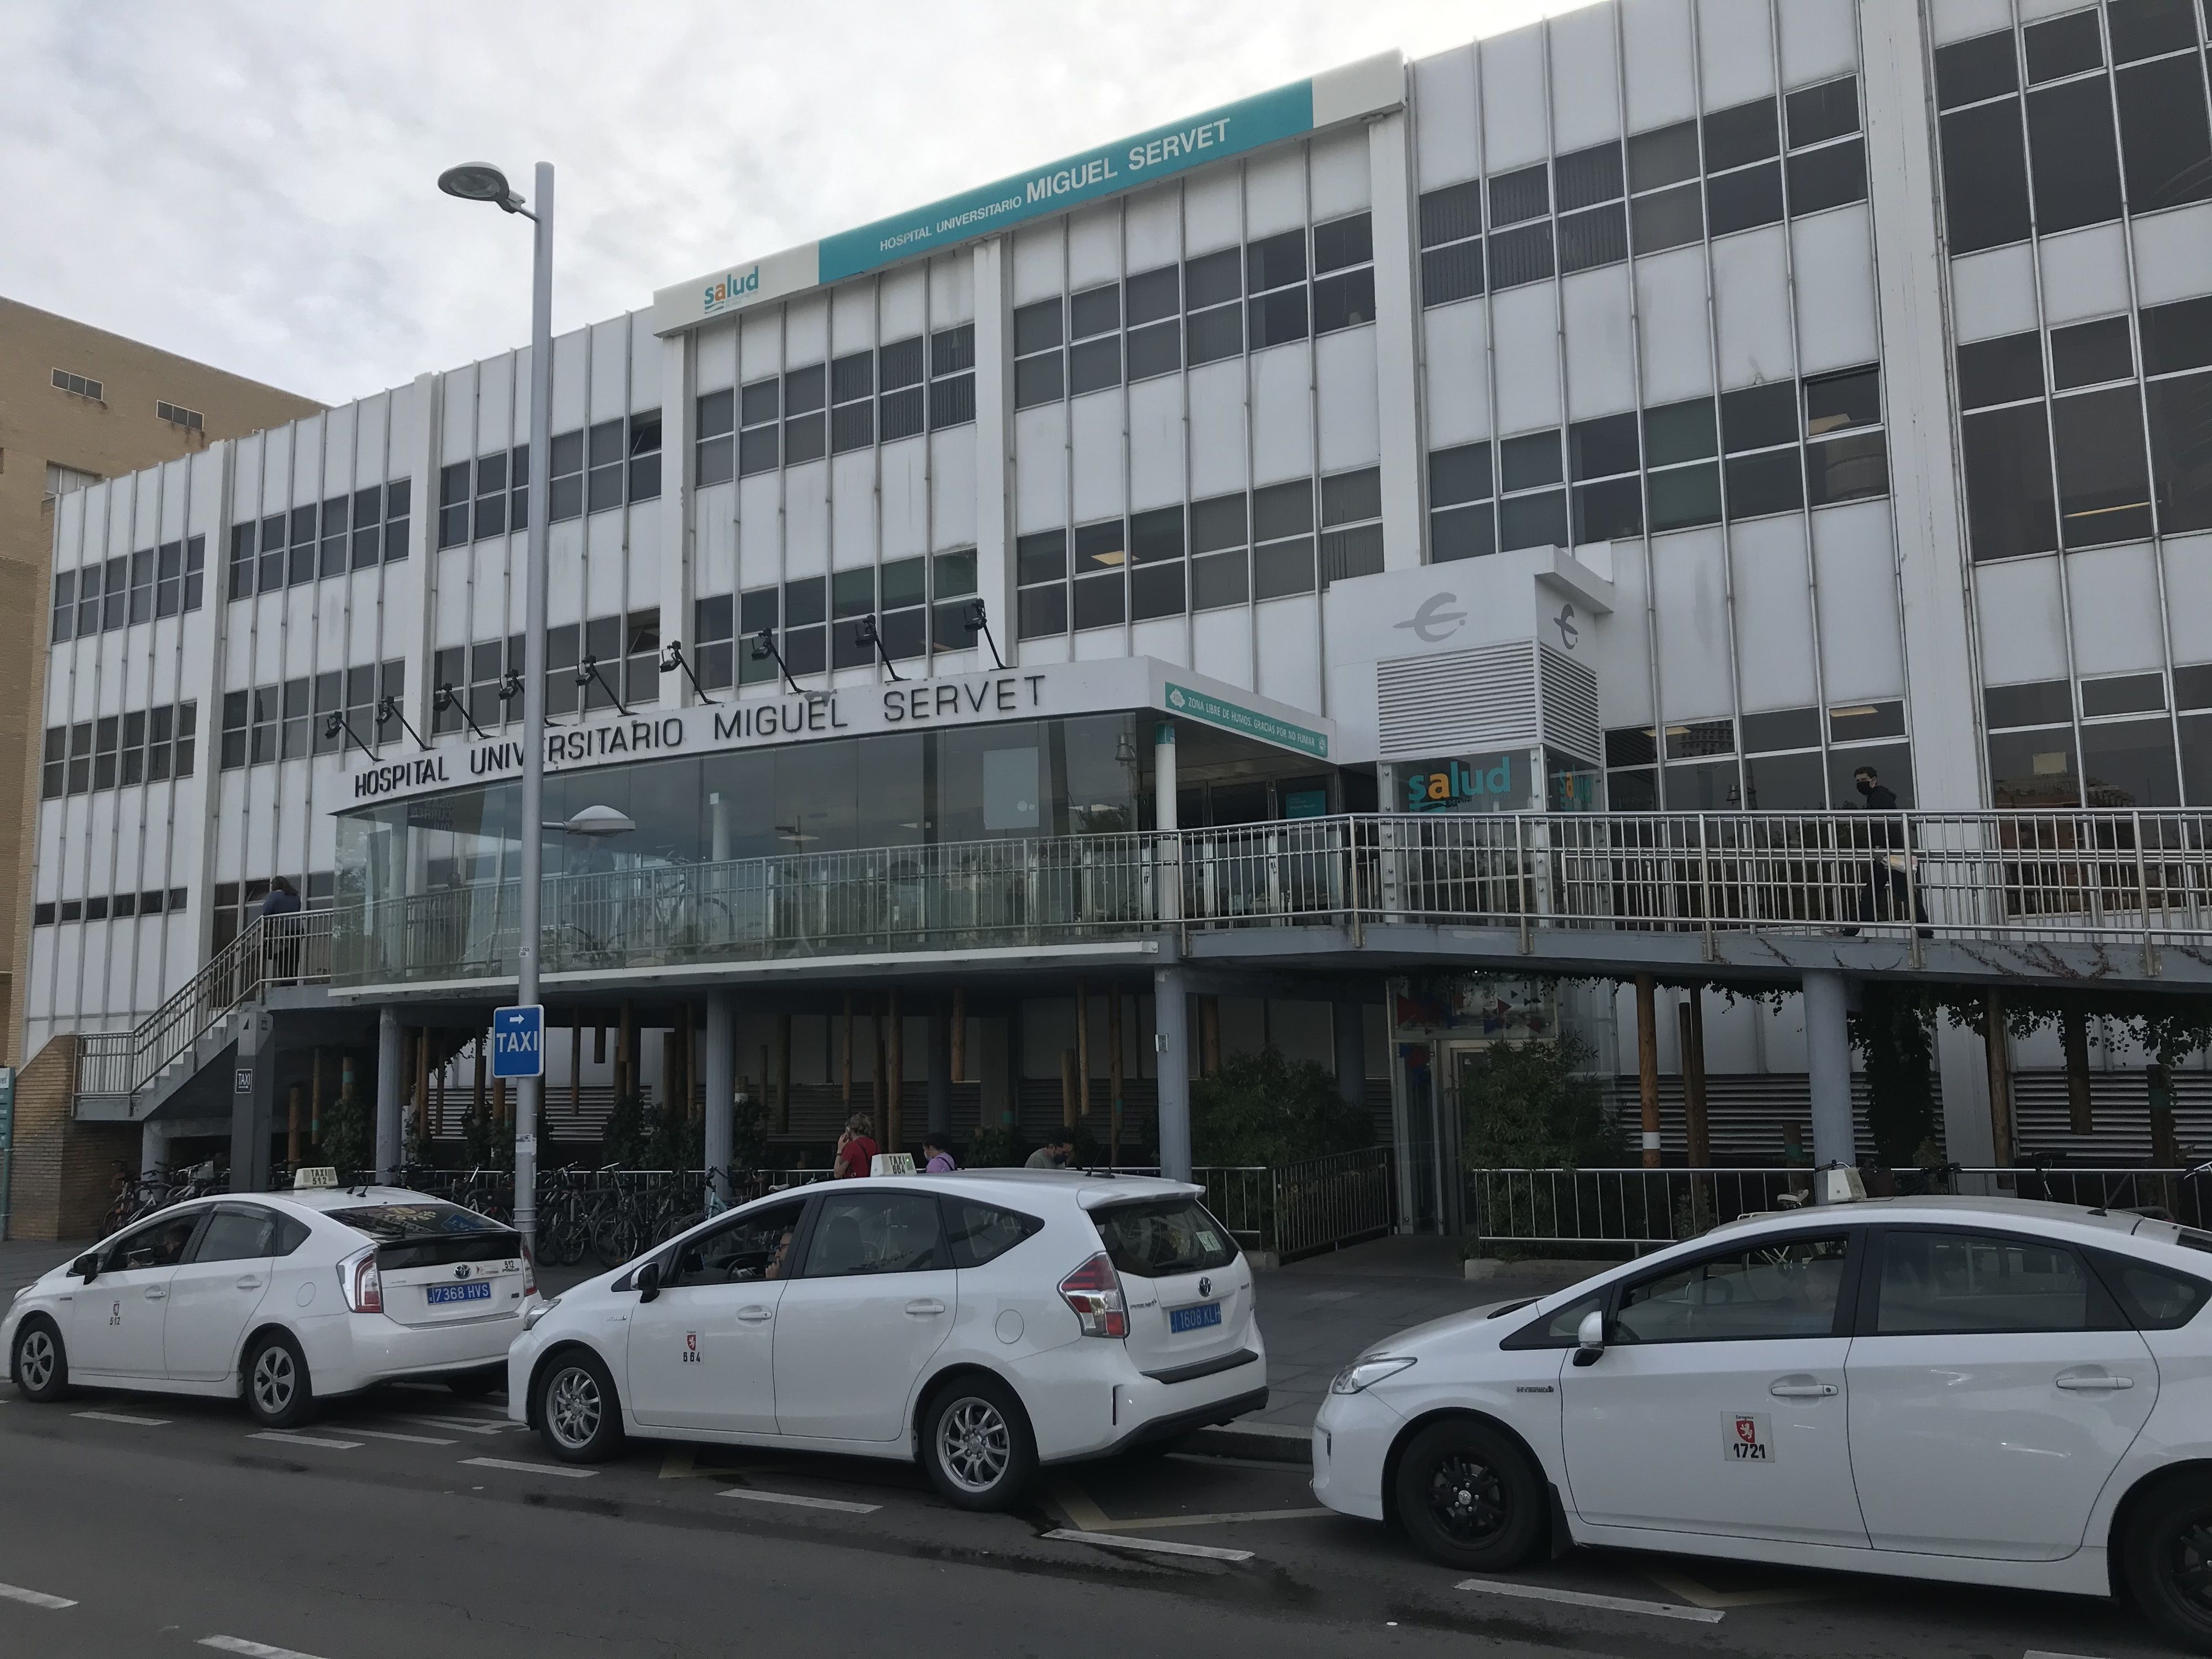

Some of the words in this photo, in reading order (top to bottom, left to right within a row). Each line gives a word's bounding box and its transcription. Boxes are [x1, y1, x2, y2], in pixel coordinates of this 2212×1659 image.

[879, 226, 932, 251] HOSPITAL
[936, 196, 1022, 233] UNIVERSITARIO
[1026, 157, 1118, 204] MIGUEL
[1128, 117, 1231, 171] SERVET
[704, 265, 759, 304] salud
[1188, 696, 1204, 712] ZONA
[1206, 702, 1221, 716] LIBRE
[1222, 708, 1229, 719] DE
[1231, 710, 1252, 727] HUMOS.
[1254, 719, 1275, 735] GRACIAS
[1277, 726, 1287, 738] POR
[1289, 730, 1296, 741] NO
[1297, 733, 1315, 747] FUMAR
[354, 755, 450, 798] HOSPITAL
[470, 718, 683, 775] UNIVRSITARIO
[714, 698, 848, 740] MIGUEL
[884, 675, 1046, 722] SERVET
[1408, 756, 1511, 801] salud
[496, 1030, 538, 1053] TAXI
[238, 1073, 251, 1085] TAXI
[889, 1155, 905, 1165] TAXI
[312, 1177, 328, 1185] 512
[504, 1260, 515, 1269] 512
[435, 1287, 465, 1301] 7368
[468, 1284, 489, 1298] HVS
[110, 1317, 121, 1325] 512
[1180, 1310, 1202, 1328] 1608
[1204, 1305, 1222, 1323] KLH
[683, 1352, 701, 1363] 664
[1734, 1443, 1766, 1459] 1721
